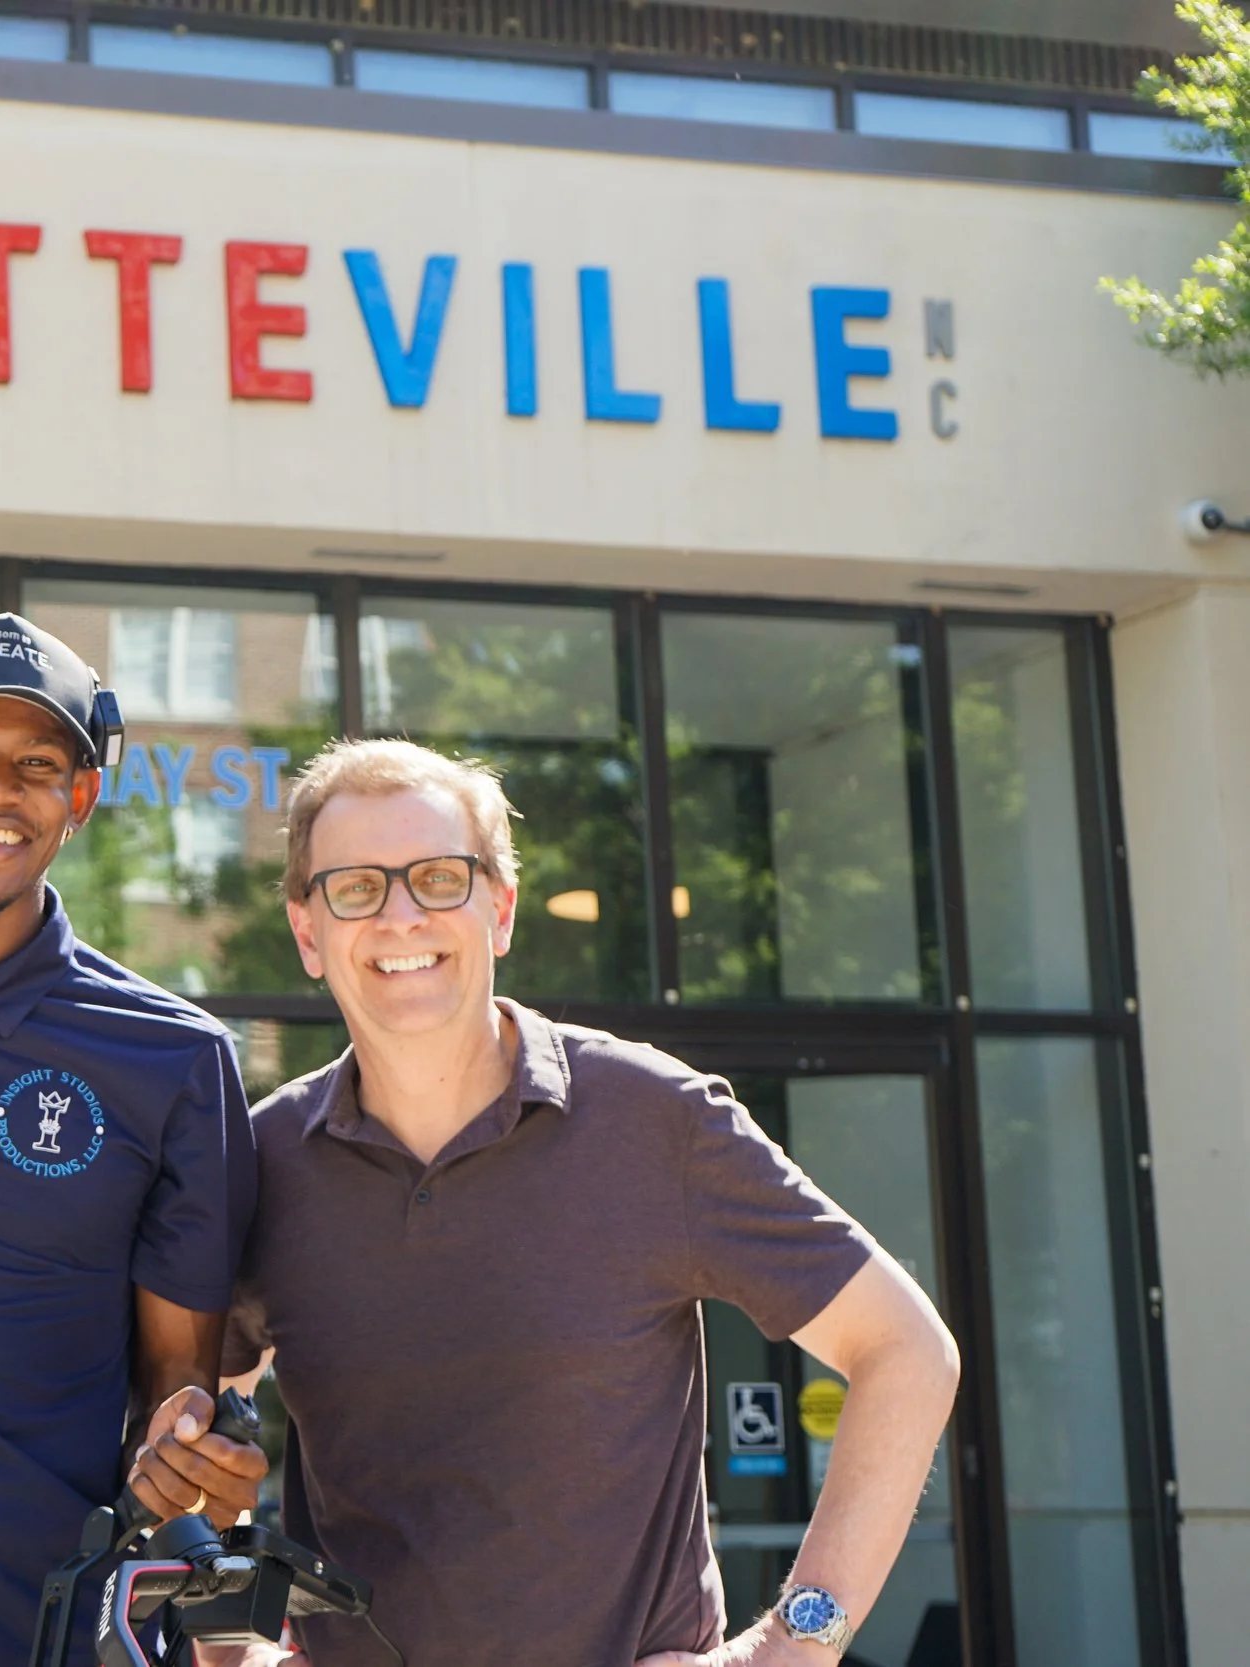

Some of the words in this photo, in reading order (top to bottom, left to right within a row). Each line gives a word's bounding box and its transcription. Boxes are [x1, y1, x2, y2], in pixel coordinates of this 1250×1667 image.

[211, 744, 290, 811] ST
[0, 1069, 53, 1106] INSIGHT
[60, 1071, 105, 1125] STUDIOS
[83, 1135, 103, 1163] LLC
[98, 1569, 117, 1641] RONIN
